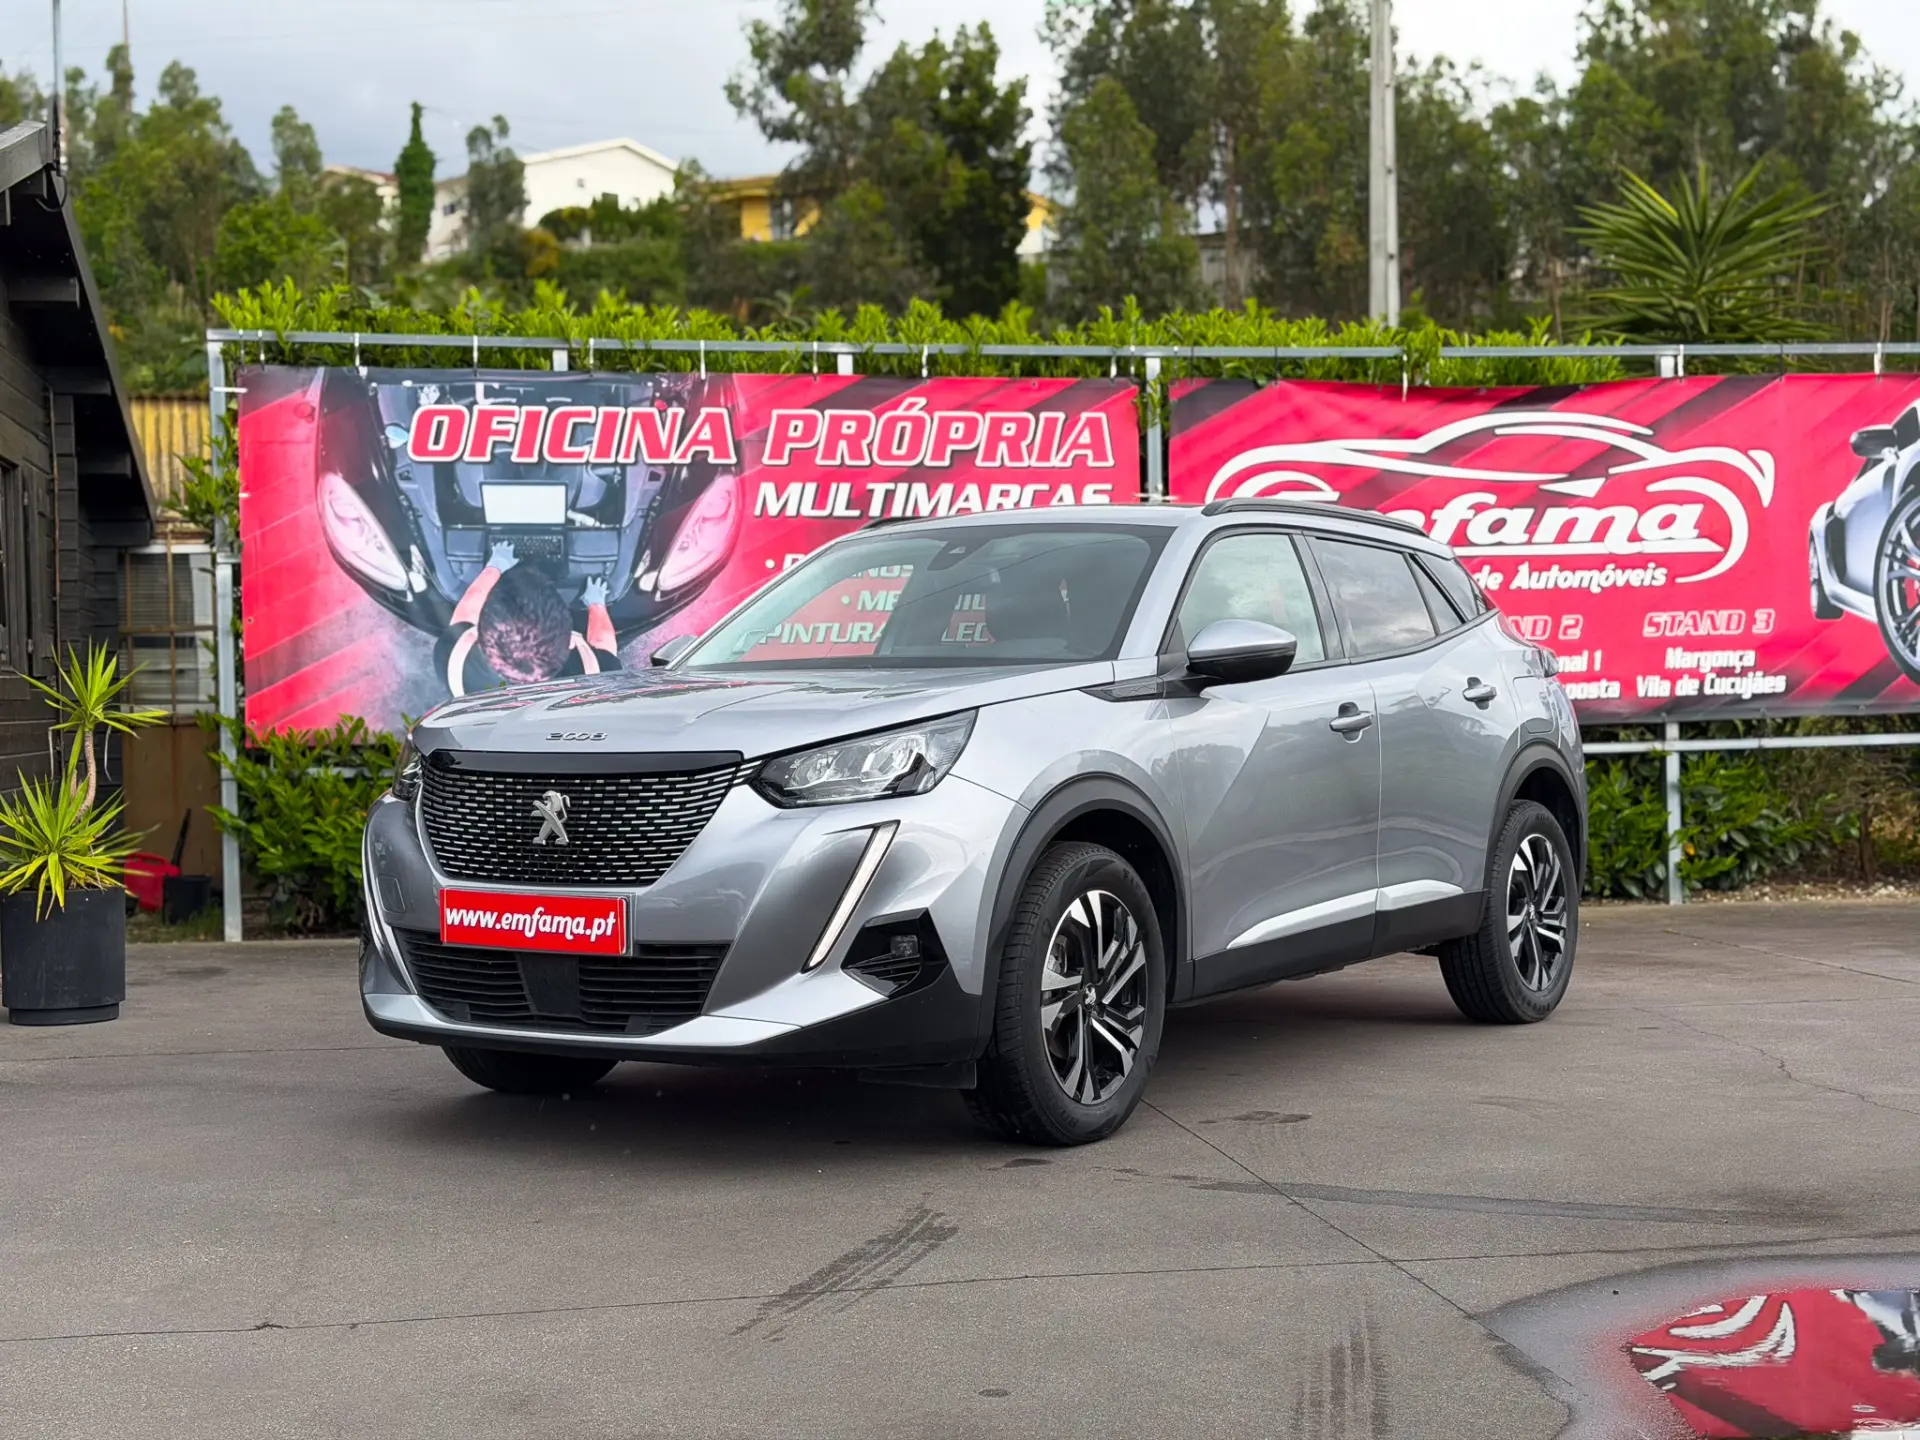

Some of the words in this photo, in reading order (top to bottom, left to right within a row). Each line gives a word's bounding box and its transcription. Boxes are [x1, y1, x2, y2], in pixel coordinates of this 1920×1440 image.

[409, 404, 737, 465] OFICINA
[762, 398, 1115, 468] PRÓPRIA
[754, 482, 1113, 517] MULTIMARCAS
[1383, 491, 1704, 555] fama
[1472, 565, 1503, 590] de
[1509, 561, 1667, 594] Automóveis
[1558, 614, 1583, 640] 2
[1642, 611, 1745, 637] STAND
[1752, 609, 1775, 634] 3
[1665, 647, 1755, 673] Margonça
[1636, 675, 1671, 697] Vila
[1675, 674, 1699, 696] de
[1703, 670, 1786, 699] Cucujães
[545, 731, 608, 741] 2008
[446, 907, 616, 942] www.emfama.pt
